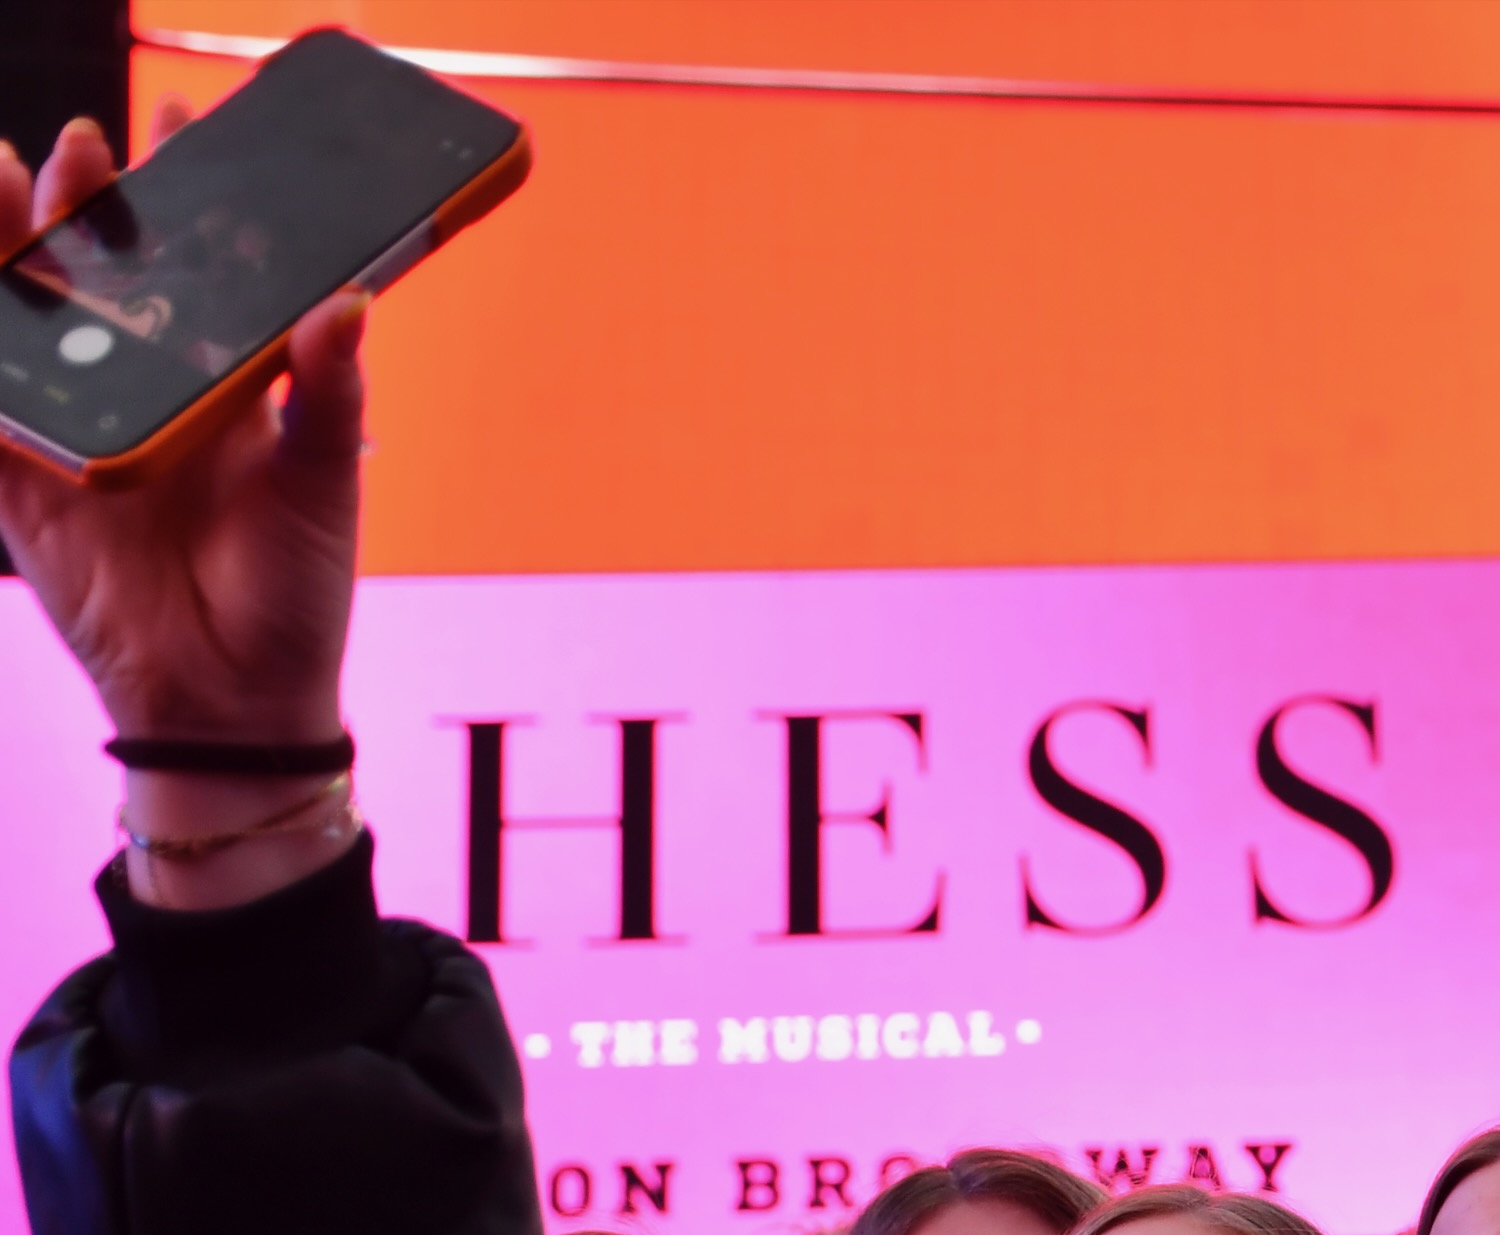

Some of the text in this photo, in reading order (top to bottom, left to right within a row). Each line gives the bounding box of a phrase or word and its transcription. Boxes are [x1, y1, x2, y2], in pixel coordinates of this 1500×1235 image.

[571, 1011, 1005, 1067] THE MUSICAL
[550, 1163, 677, 1217] ON
